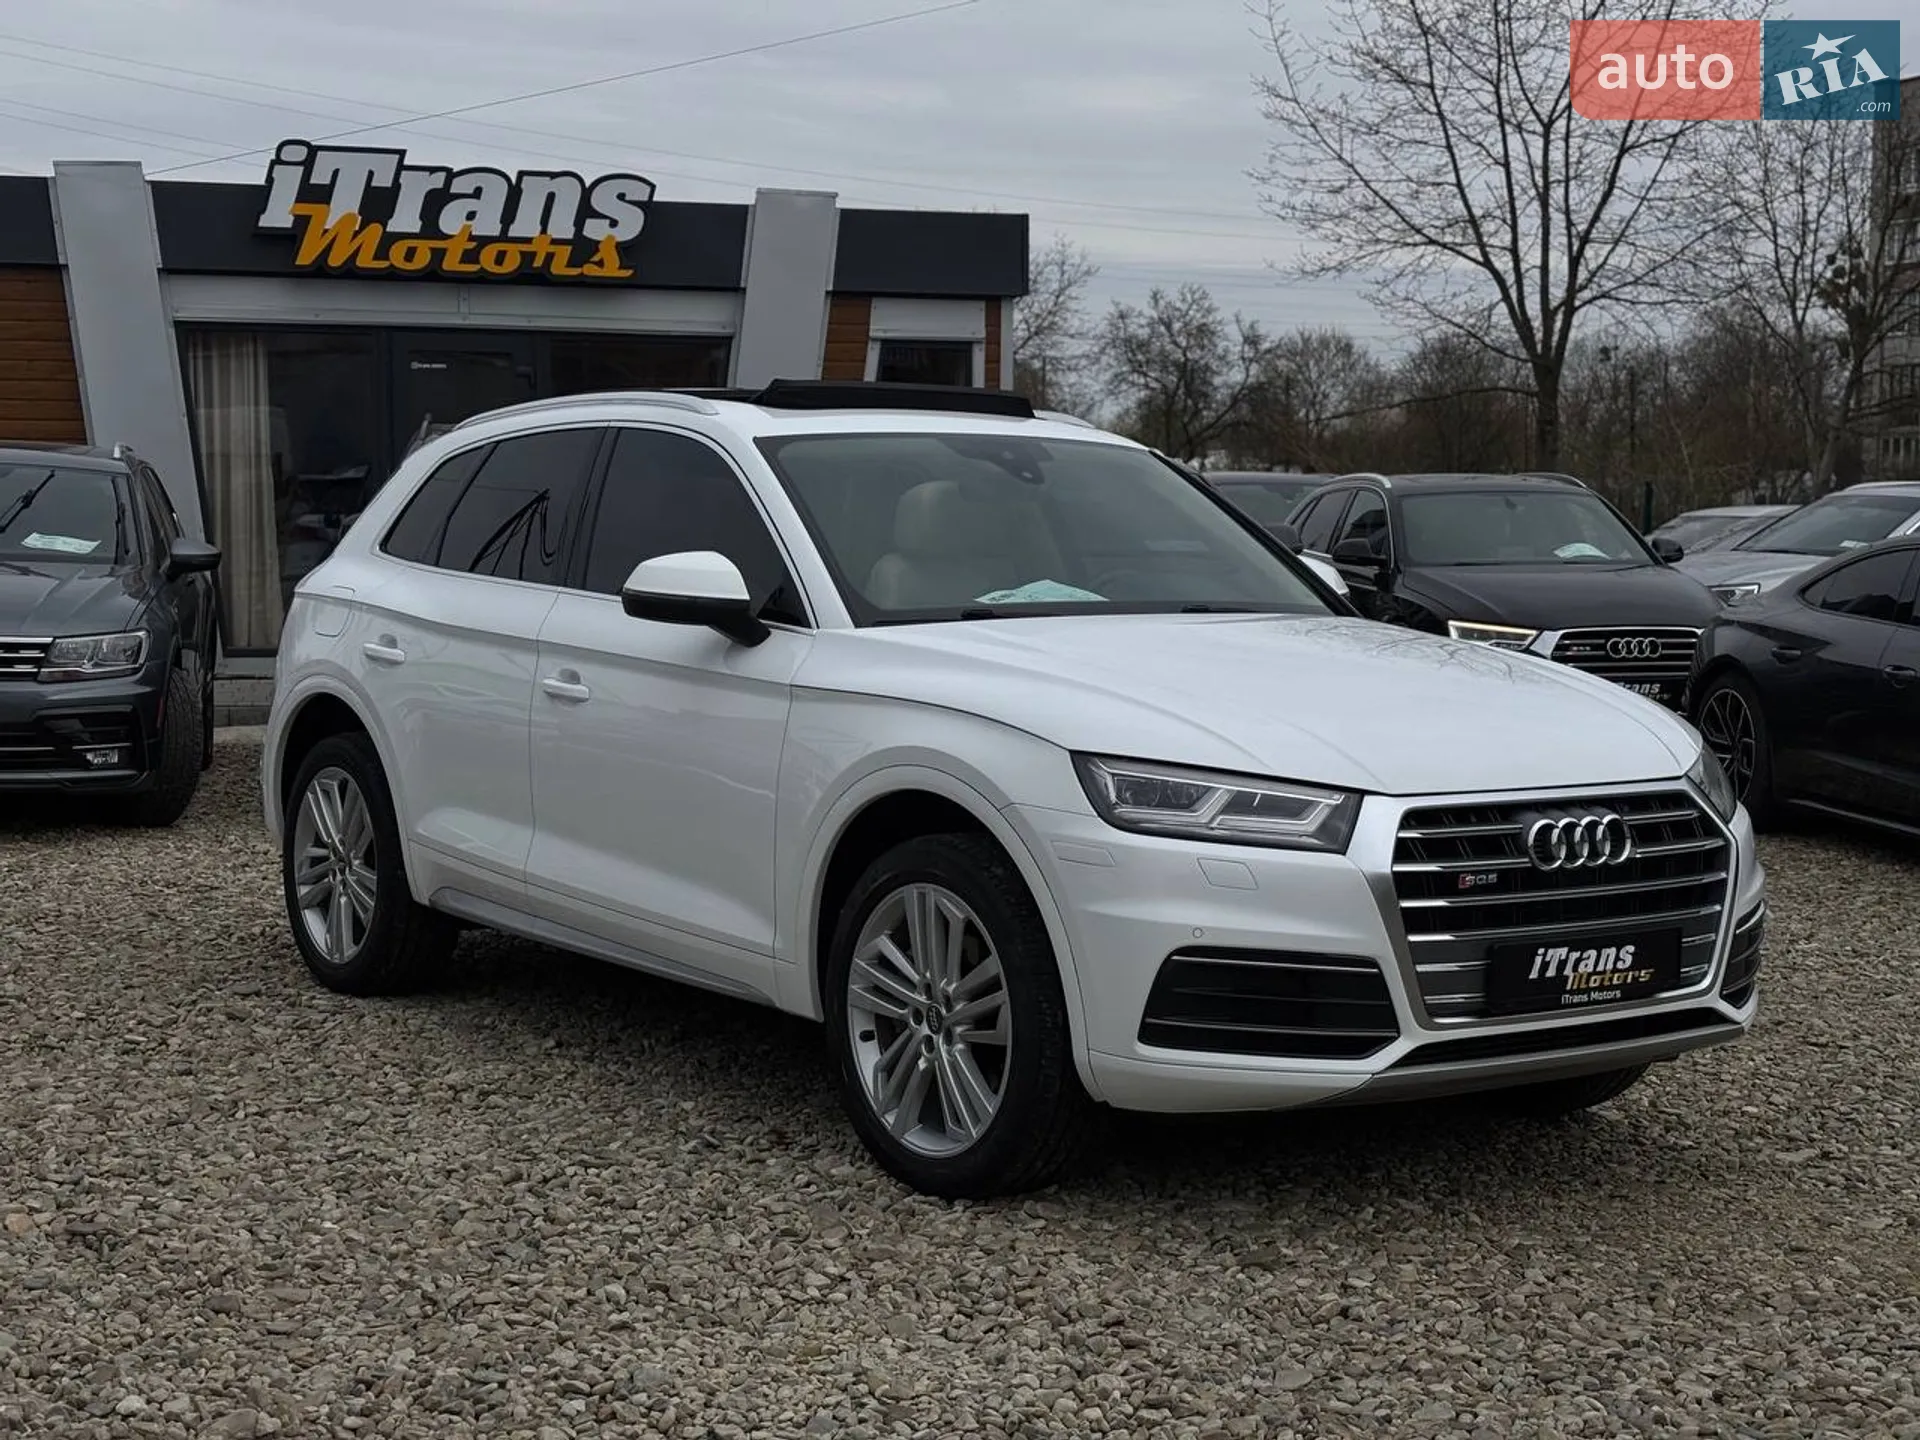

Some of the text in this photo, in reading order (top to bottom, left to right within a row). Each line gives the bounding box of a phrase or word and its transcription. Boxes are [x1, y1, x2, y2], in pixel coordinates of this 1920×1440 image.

[257, 143, 649, 242] iTrans
[290, 202, 634, 278] Motors
[1529, 945, 1635, 979] iTrans
[1566, 969, 1655, 990] Motors
[1590, 990, 1622, 1001] Motors
